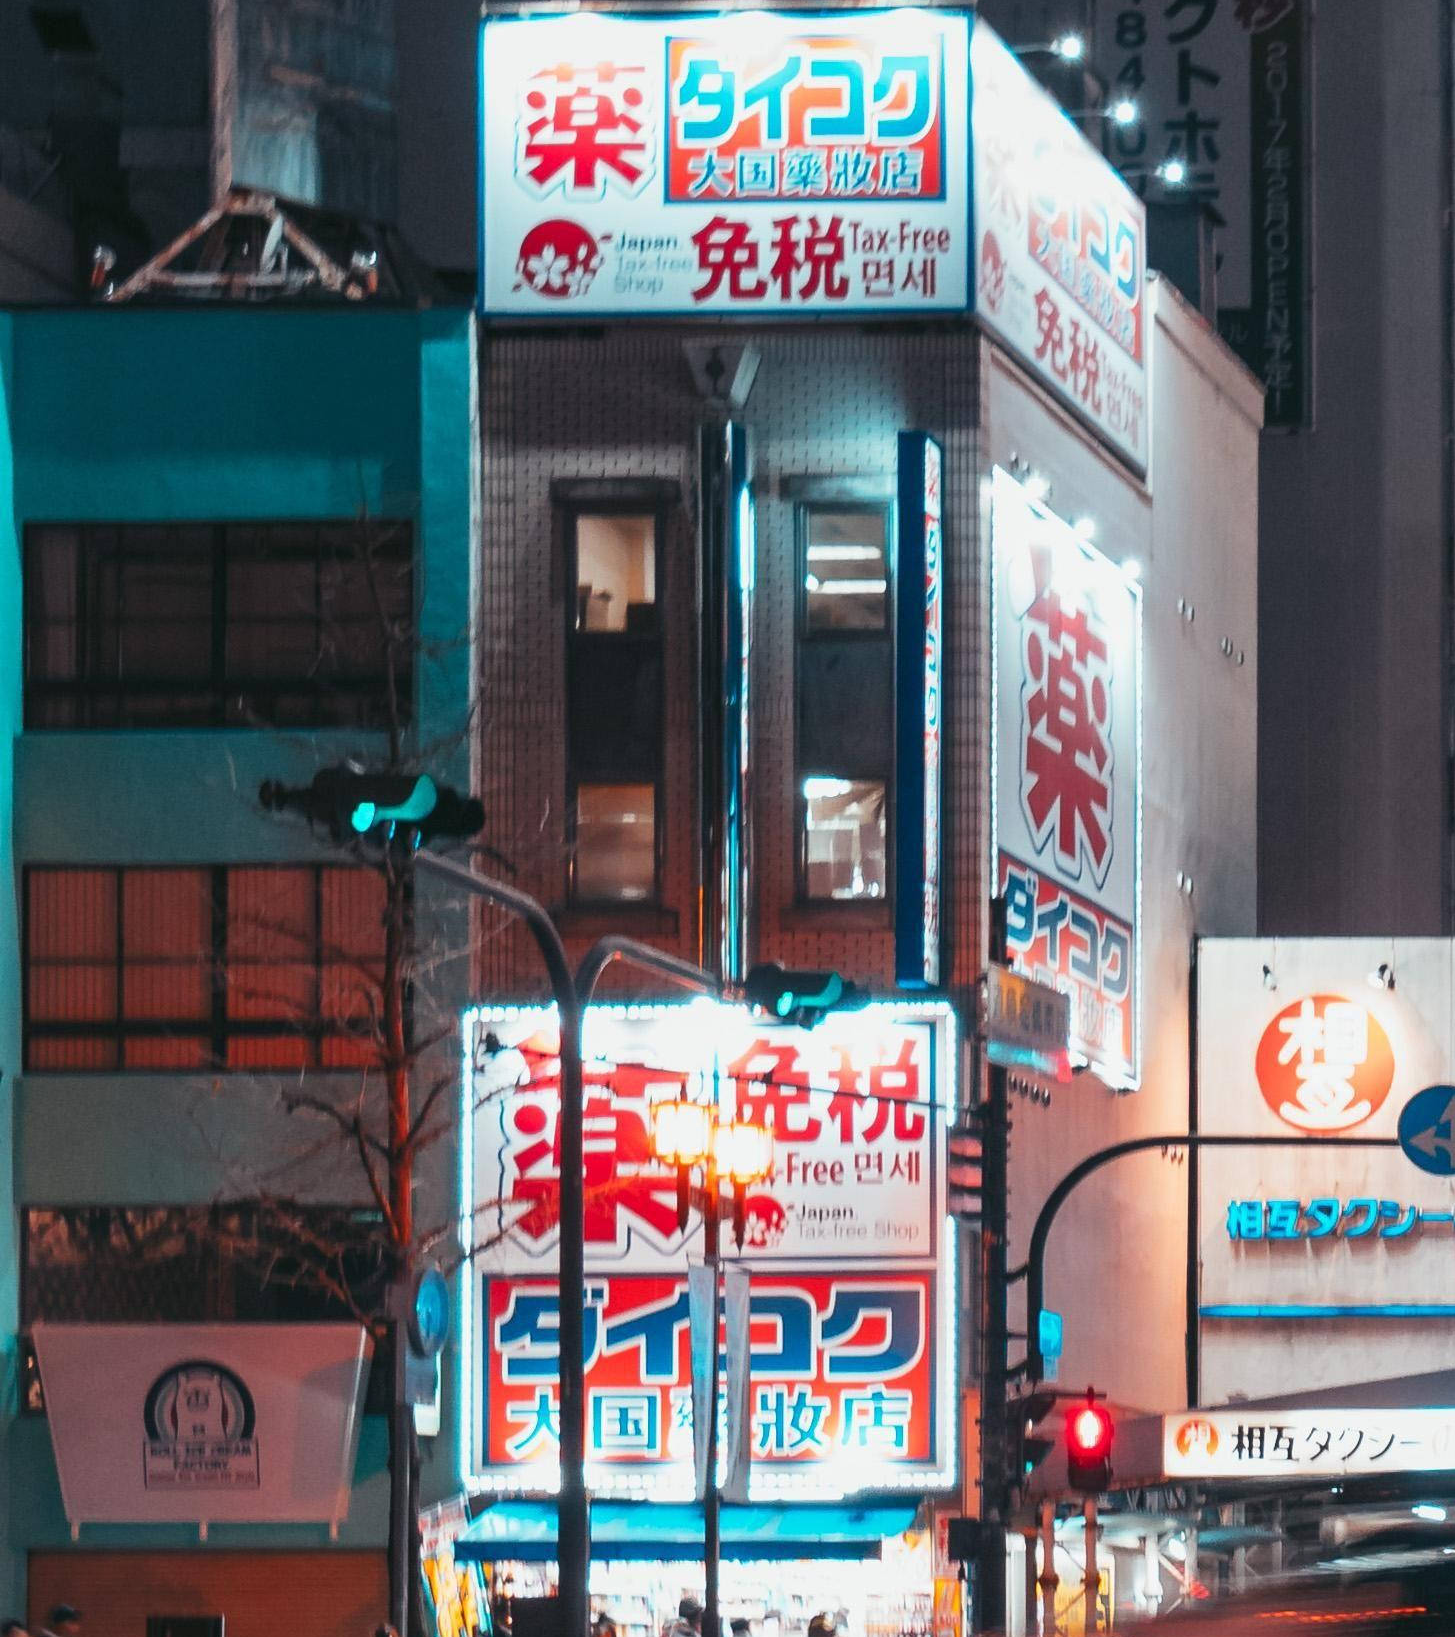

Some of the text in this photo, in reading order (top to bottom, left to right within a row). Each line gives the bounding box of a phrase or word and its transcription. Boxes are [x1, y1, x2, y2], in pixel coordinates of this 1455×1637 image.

[523, 63, 646, 189] 薬
[690, 215, 850, 304] 免税
[848, 219, 951, 255] Tax-Free
[861, 257, 938, 299] 면세
[1032, 285, 1104, 423] 免税
[1026, 583, 1110, 887] 薬
[726, 1038, 926, 1144] 免税
[854, 1151, 920, 1185] 면세
[874, 1221, 921, 1243] Shop
[498, 1288, 926, 1379] ダイコク
